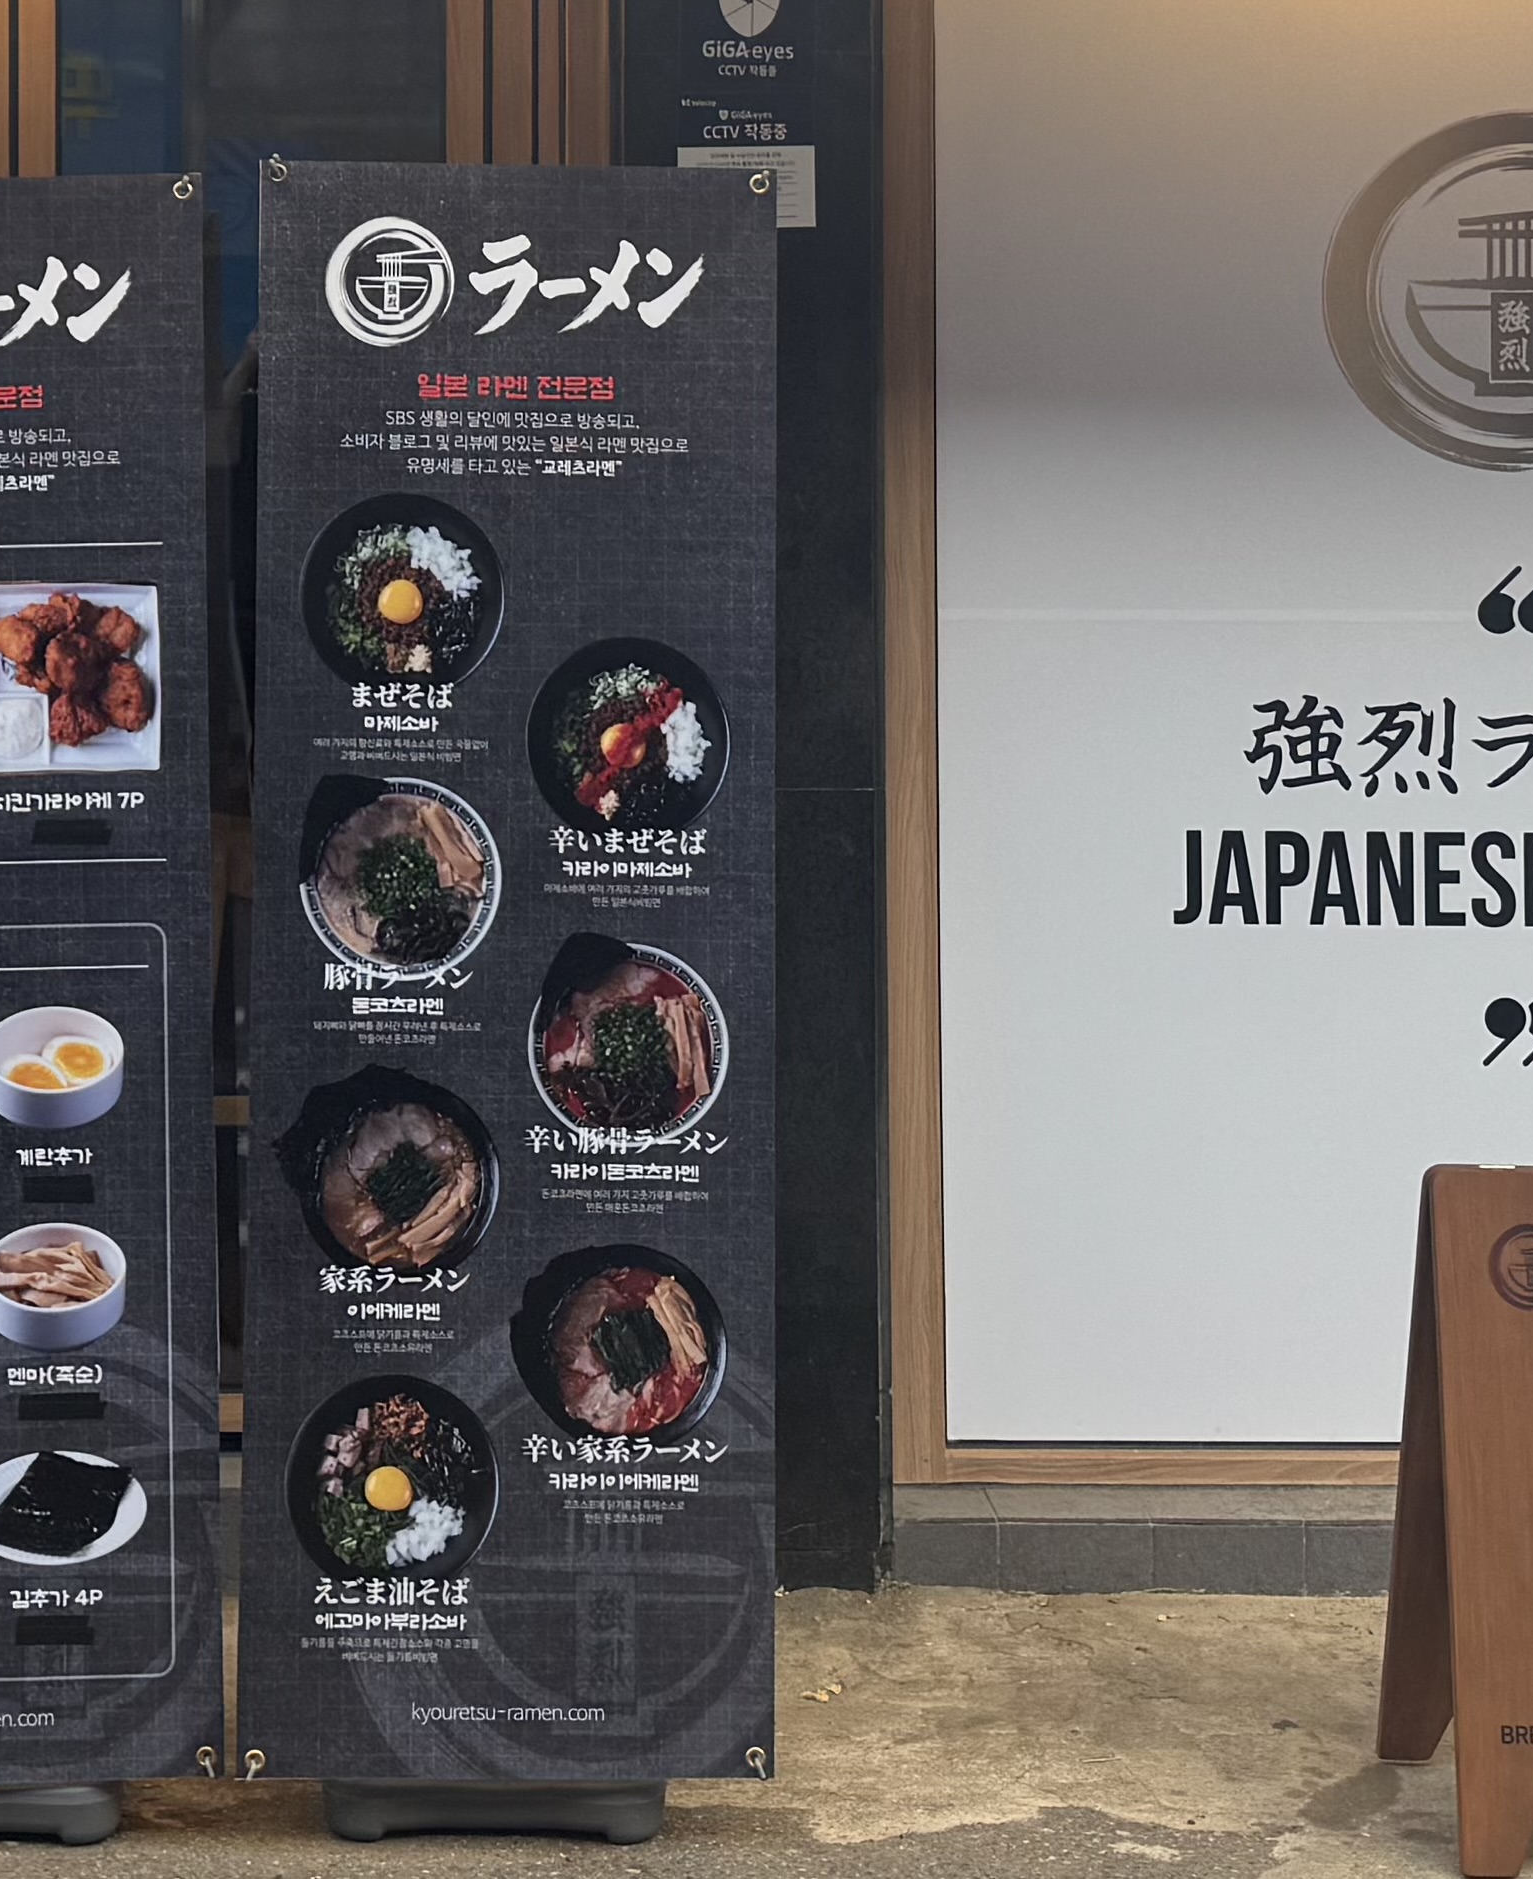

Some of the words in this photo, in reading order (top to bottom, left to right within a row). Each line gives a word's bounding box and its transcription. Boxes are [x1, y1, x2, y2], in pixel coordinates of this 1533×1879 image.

[718, 65, 746, 76] CCTV
[703, 125, 740, 139] CCTV
[744, 123, 788, 141] 작동중
[469, 234, 705, 335] ラーメン
[418, 373, 467, 399] 일본
[478, 374, 528, 399] 라멘
[537, 374, 615, 401] 전문점
[385, 410, 415, 427] SBS
[419, 410, 463, 427] 생활의
[467, 411, 511, 428] 달인에
[514, 411, 573, 428] 맛집으로
[339, 432, 385, 450] 소비자
[387, 433, 432, 451] 블로그
[453, 433, 498, 451] 리뷰에
[501, 434, 546, 452] 맛있는
[550, 435, 594, 453] 일본식
[597, 435, 627, 453] 라멘
[630, 435, 689, 453] 맛집으로
[29, 451, 59, 468] 라멘
[62, 450, 121, 467] 맛집으로
[406, 458, 465, 474] 유명세를
[468, 459, 499, 475] 타고
[502, 459, 532, 475] 있는
[351, 682, 455, 710] まぜそば
[364, 715, 440, 733] 마제소바
[117, 792, 145, 809] 7P
[548, 826, 707, 855] 辛いまぜそば
[562, 861, 693, 879] 카라이마제소바
[352, 996, 444, 1015] 돈코츠라멘
[15, 1147, 92, 1167] 계란추가
[550, 1163, 699, 1182] 카라이돈코츠라멘
[319, 1265, 471, 1294] 家系ラーメン
[347, 1303, 441, 1321] 이에케라멘
[521, 1434, 729, 1464] 辛い家系ラーメン
[549, 1473, 699, 1492] 카라이이에케라멘
[9, 1589, 69, 1608] 김추가
[74, 1589, 103, 1606] 4P
[314, 1576, 470, 1606] えごま油そば
[315, 1613, 467, 1632] 에고마아부라소바
[411, 1702, 605, 1725] kyouretsu-ramen.com
